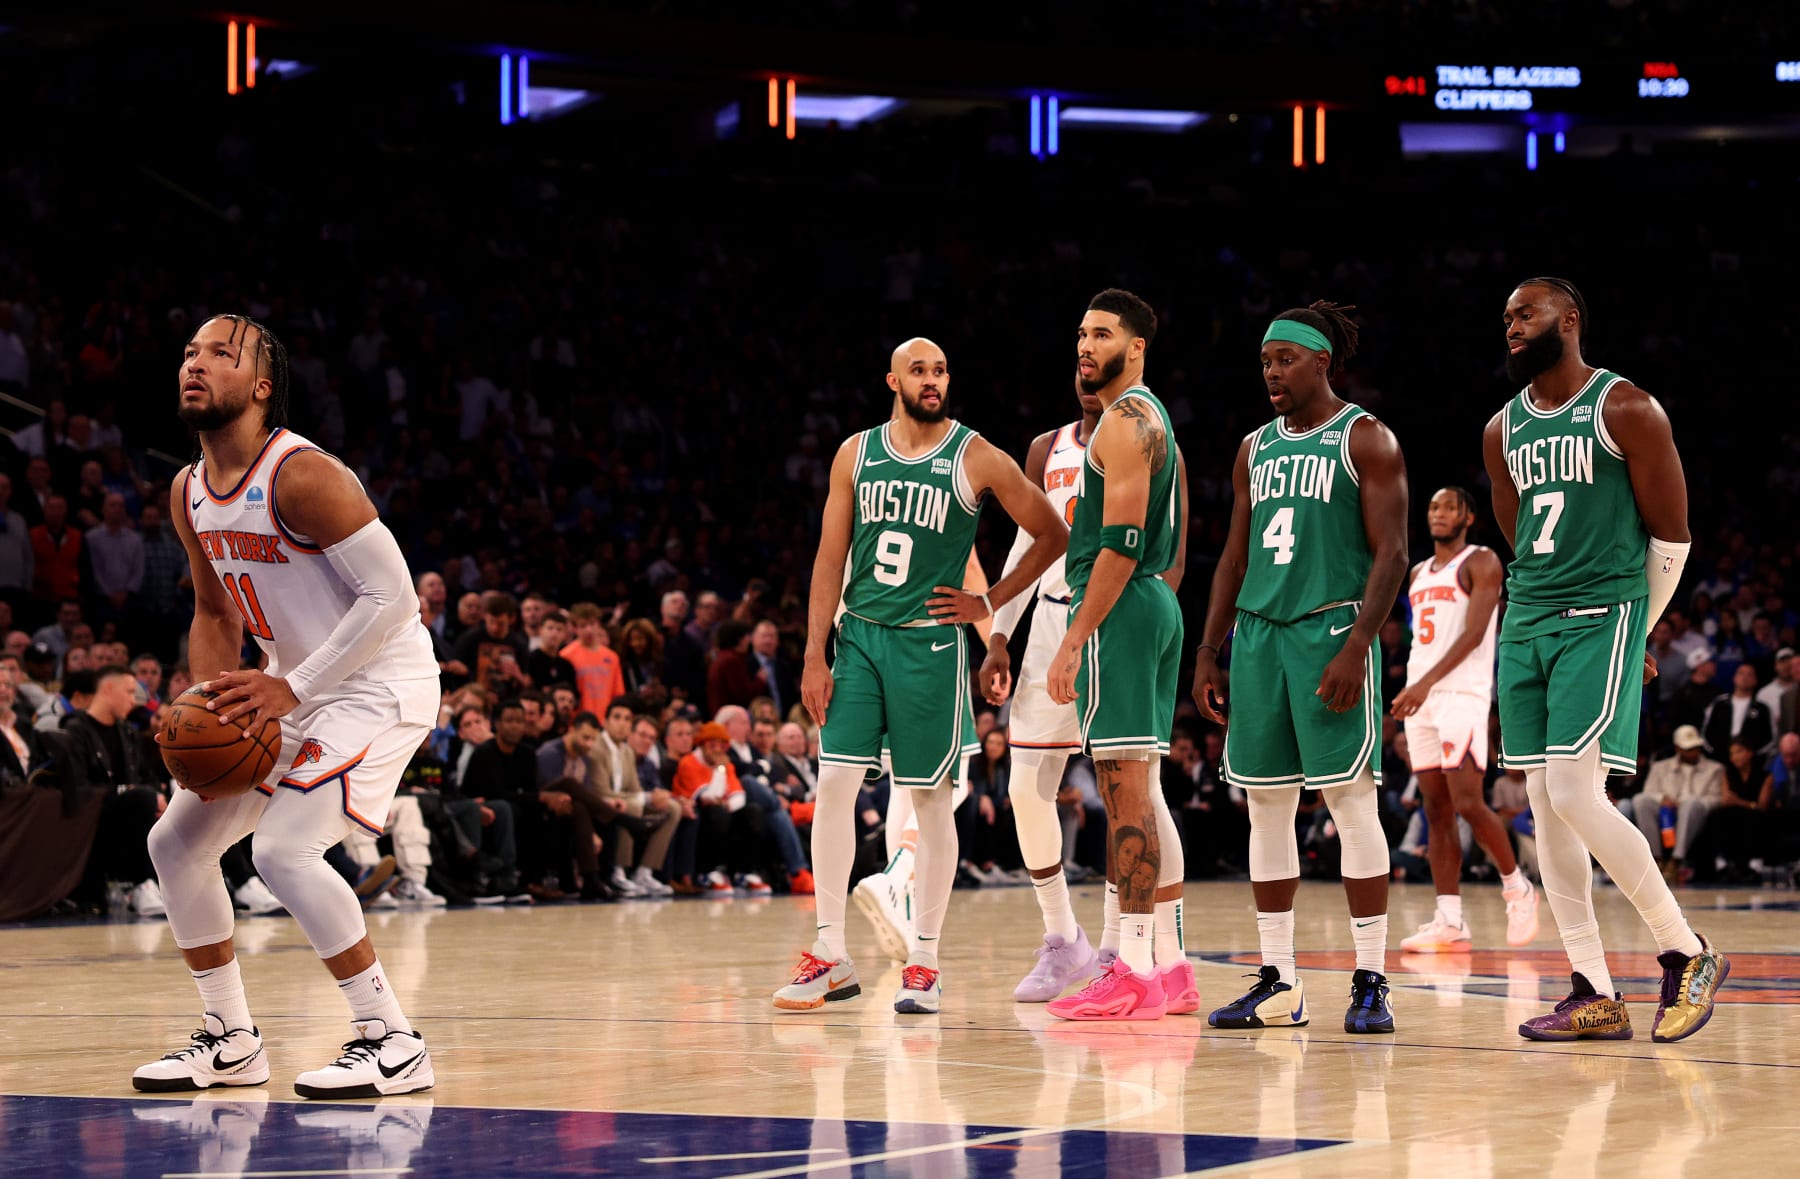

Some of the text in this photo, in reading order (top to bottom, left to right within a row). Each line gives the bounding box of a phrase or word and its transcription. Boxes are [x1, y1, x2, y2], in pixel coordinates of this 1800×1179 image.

[1436, 65, 1581, 87] TRAIL BLAZERS
[1434, 88, 1533, 110] CLIPPERS
[1571, 414, 1592, 424] PRINT
[1572, 405, 1592, 415] VISTA
[1319, 438, 1341, 446] PRINT
[1322, 430, 1342, 440] VISTA
[930, 466, 951, 476] PRINT
[932, 458, 952, 470] VISTA
[1507, 435, 1594, 498] BOSTON
[1250, 454, 1337, 511] BOSTON
[244, 503, 267, 511] sphere
[859, 479, 951, 534] BOSTON
[1532, 491, 1565, 555] 7
[197, 530, 290, 564] EW YORK
[1262, 507, 1296, 565] 4
[873, 530, 914, 587] 9
[222, 572, 276, 641] 11
[1419, 606, 1436, 645] 5
[1578, 1011, 1622, 1029] Naismith
